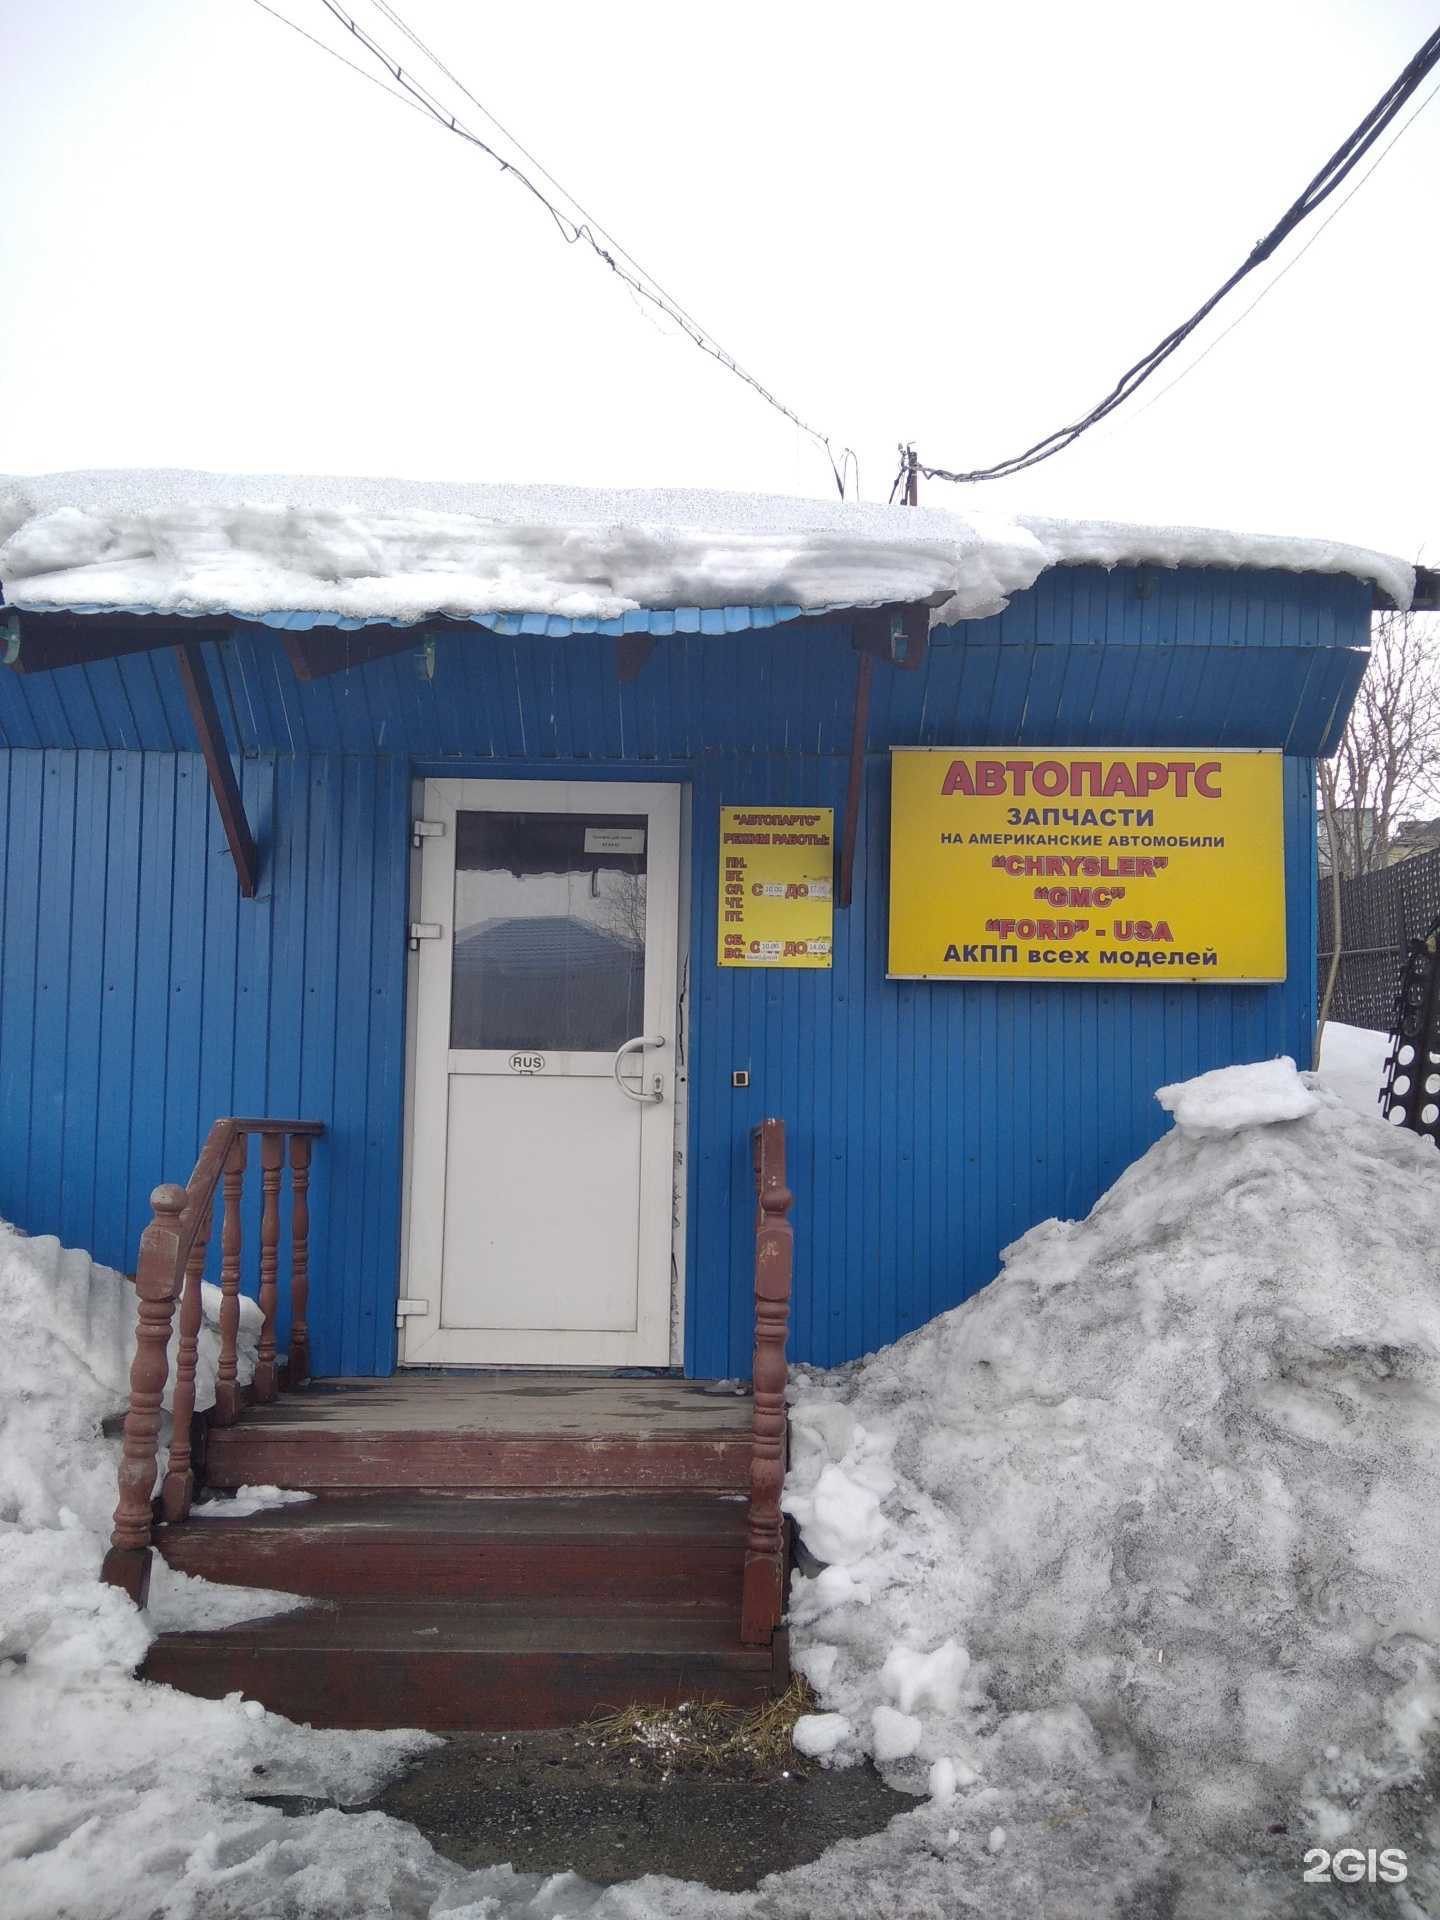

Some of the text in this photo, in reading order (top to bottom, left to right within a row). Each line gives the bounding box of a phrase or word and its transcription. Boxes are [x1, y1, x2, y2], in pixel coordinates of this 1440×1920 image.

[941, 760, 1222, 799] АВТОПАРТС
[1007, 807, 1154, 827] ЗАПЧАСТИ
[940, 832, 1225, 848] НА АМЕРИКАНСКИЕ АВТОМОБИЛИ
[1113, 920, 1173, 942] USA
[944, 944, 1218, 967] АКПП всех моделей
[513, 1056, 542, 1069] RUS
